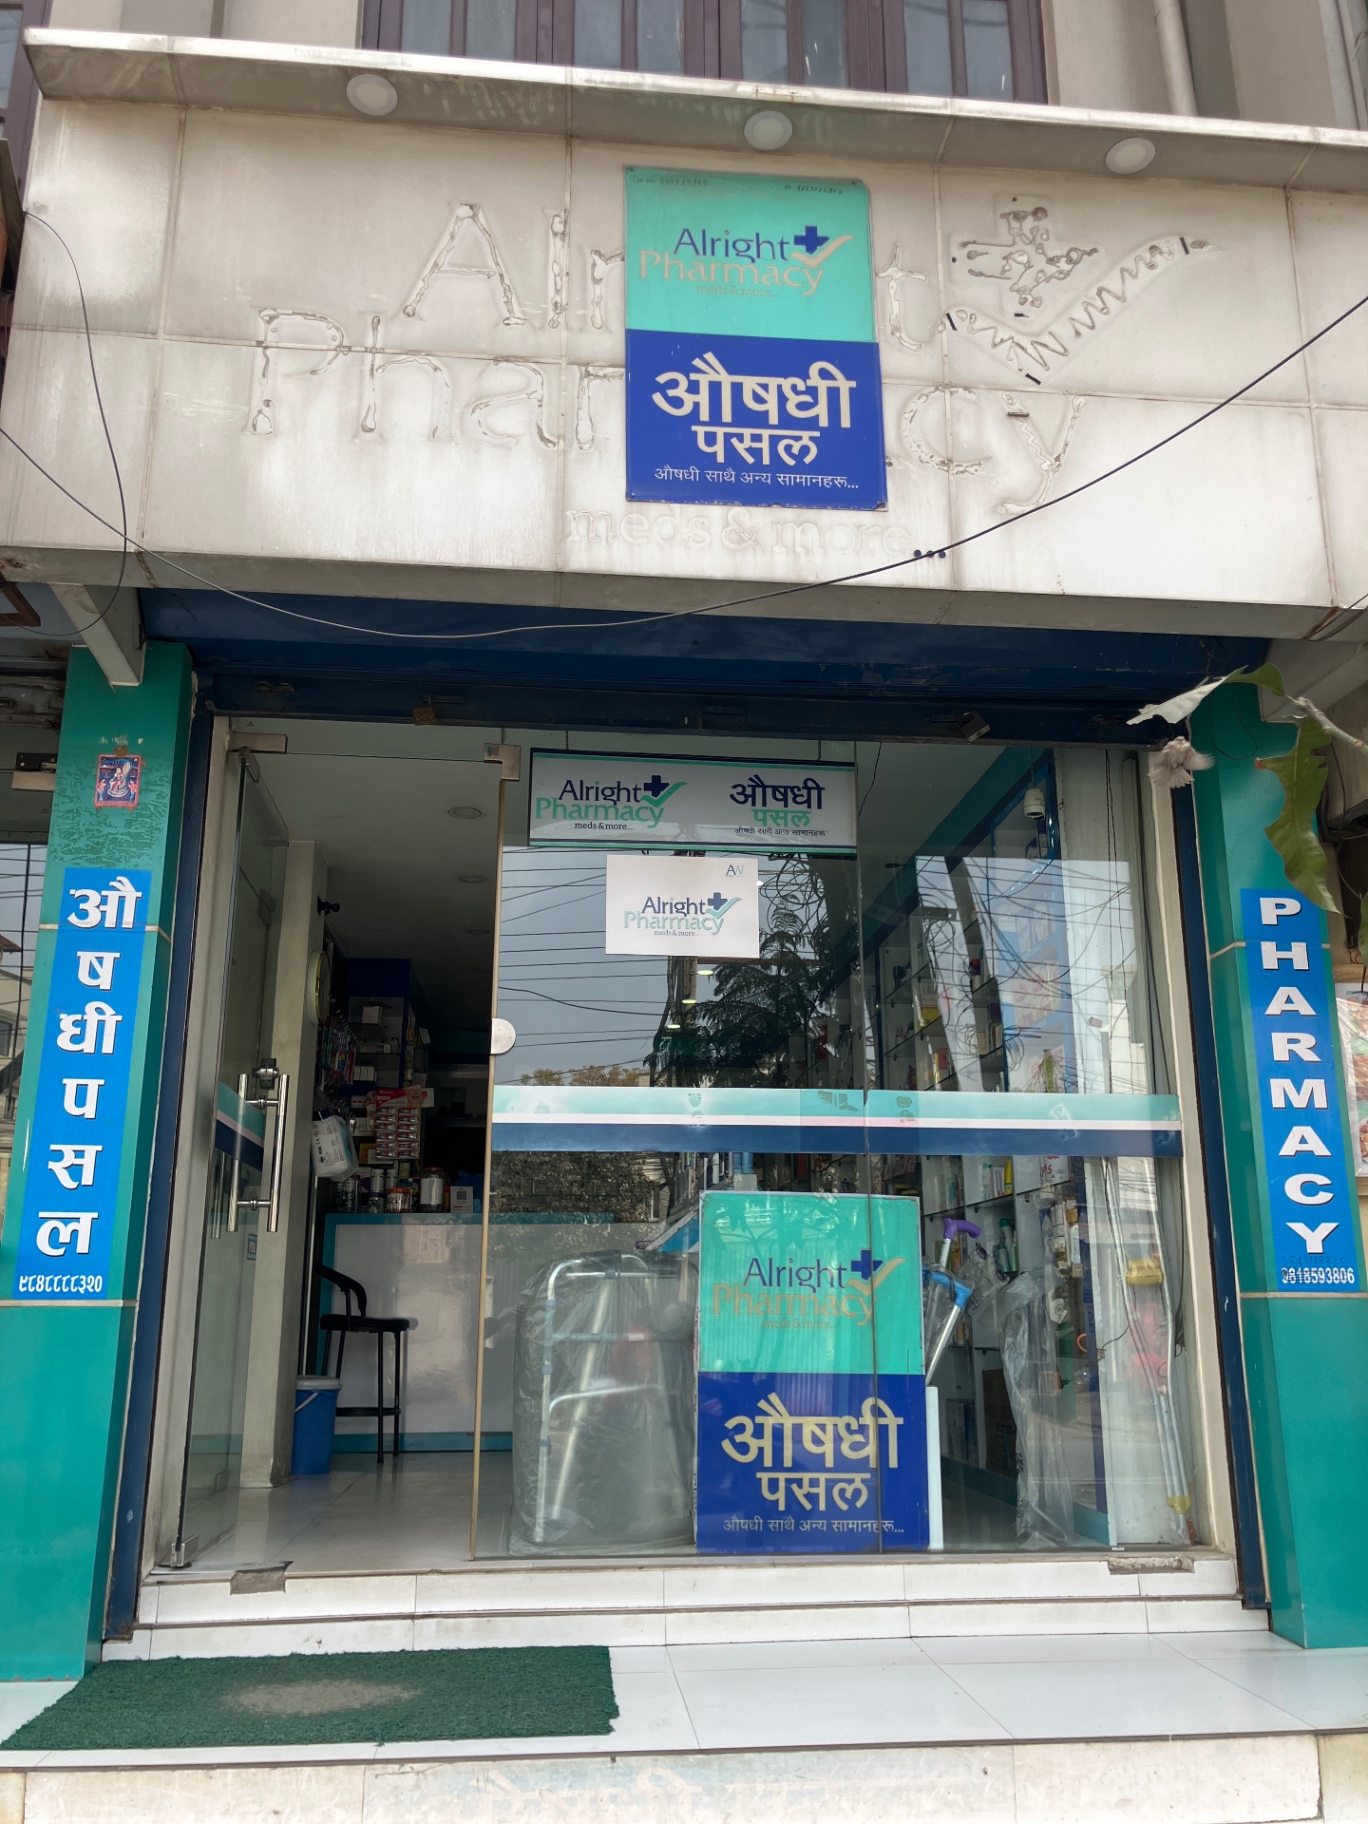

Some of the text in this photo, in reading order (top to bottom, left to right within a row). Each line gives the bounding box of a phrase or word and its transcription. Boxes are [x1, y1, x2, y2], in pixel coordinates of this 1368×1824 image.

[673, 228, 790, 263] Alright
[639, 250, 823, 296] Pharmacy
[696, 285, 728, 295] meds
[652, 352, 856, 428] औषधी
[242, 308, 1086, 515] Pharcy
[691, 425, 820, 466] पसल
[654, 464, 699, 483] औषधी
[705, 467, 736, 484] साथै
[740, 472, 772, 486] अन्य
[566, 505, 713, 549] meds
[558, 780, 642, 806] Alright
[729, 774, 825, 810] औषधी
[535, 797, 664, 828] Pharmacy
[574, 822, 597, 830] meds
[751, 808, 811, 827] पसल
[623, 910, 724, 936] Pharmacy
[641, 896, 706, 917] Alright
[1259, 897, 1340, 1254] PHARMACY
[743, 1257, 847, 1294] Alright
[712, 1284, 877, 1327] Pharmacy
[762, 1318, 791, 1329] meds
[721, 1392, 904, 1469] औषधी
[756, 1471, 871, 1512] पसल
[723, 1515, 763, 1532] औषधी
[768, 1516, 795, 1532] साथै
[799, 1519, 827, 1533] अन्य
